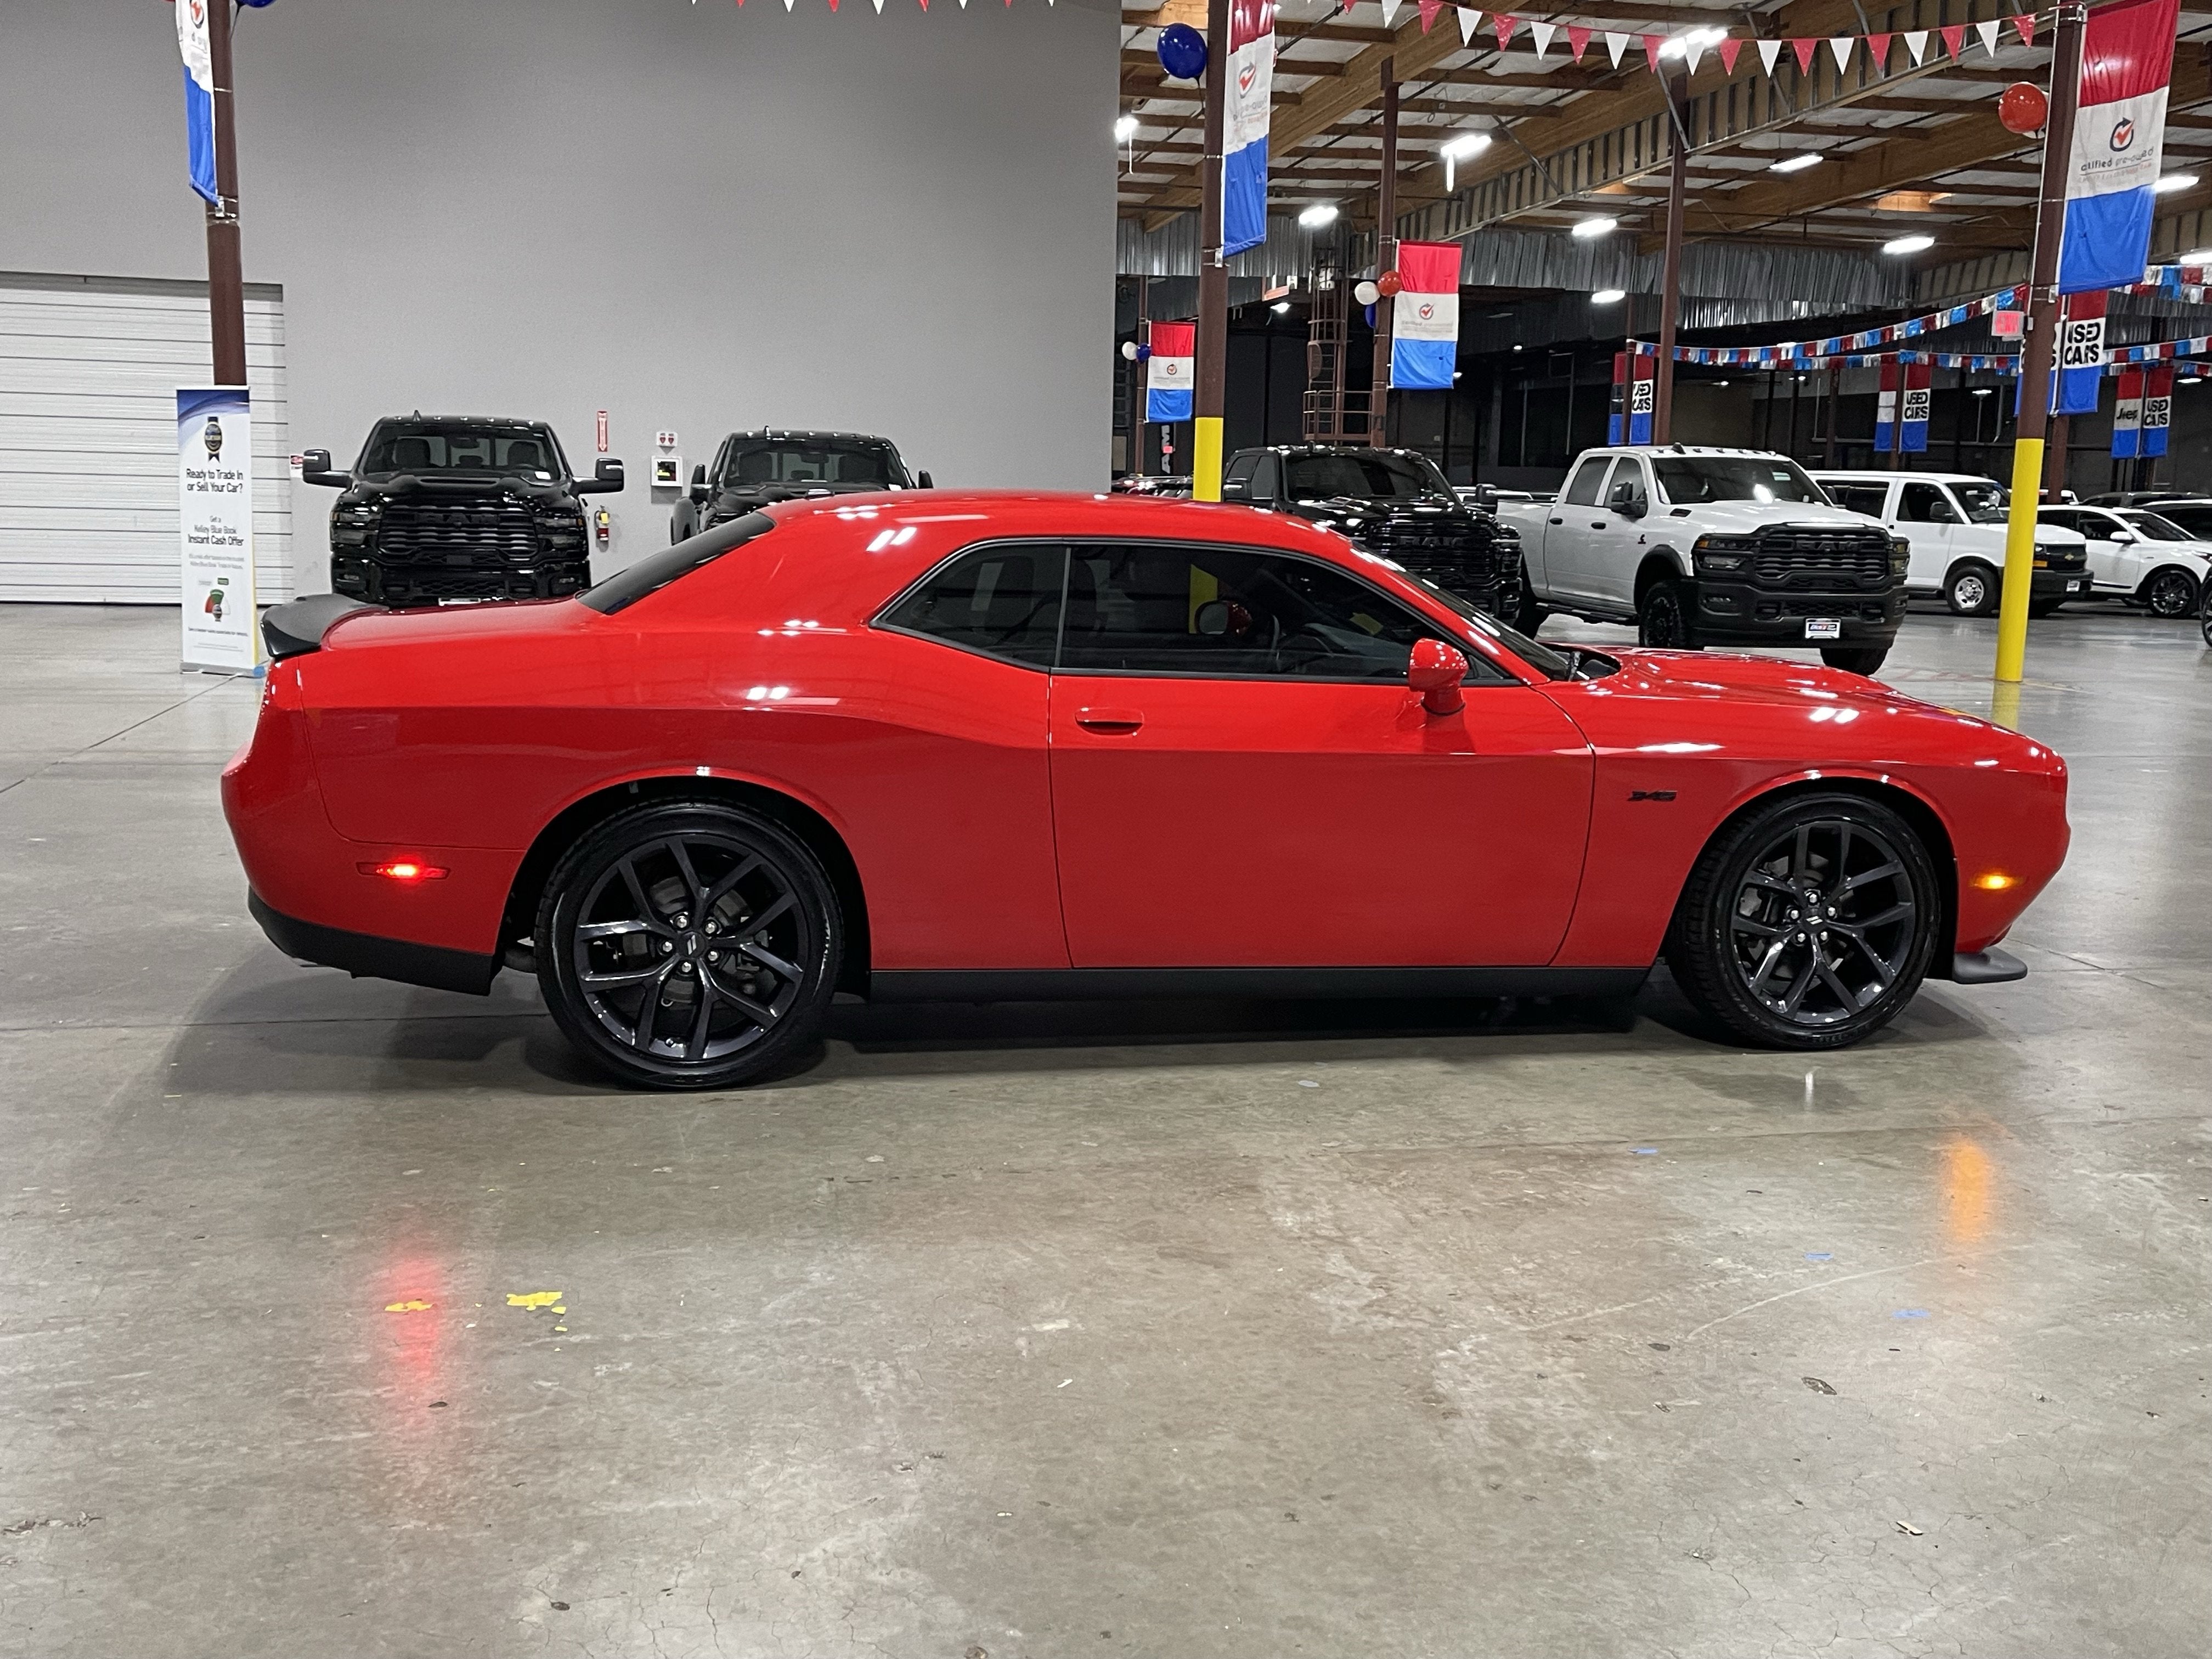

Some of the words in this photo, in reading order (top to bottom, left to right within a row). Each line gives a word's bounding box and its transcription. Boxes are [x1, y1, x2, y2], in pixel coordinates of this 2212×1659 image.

[187, 469, 206, 481] Ready
[208, 470, 215, 479] to
[216, 469, 235, 479] Trade
[196, 482, 208, 492] Sell
[210, 482, 225, 492] Your
[227, 483, 242, 493] Car?
